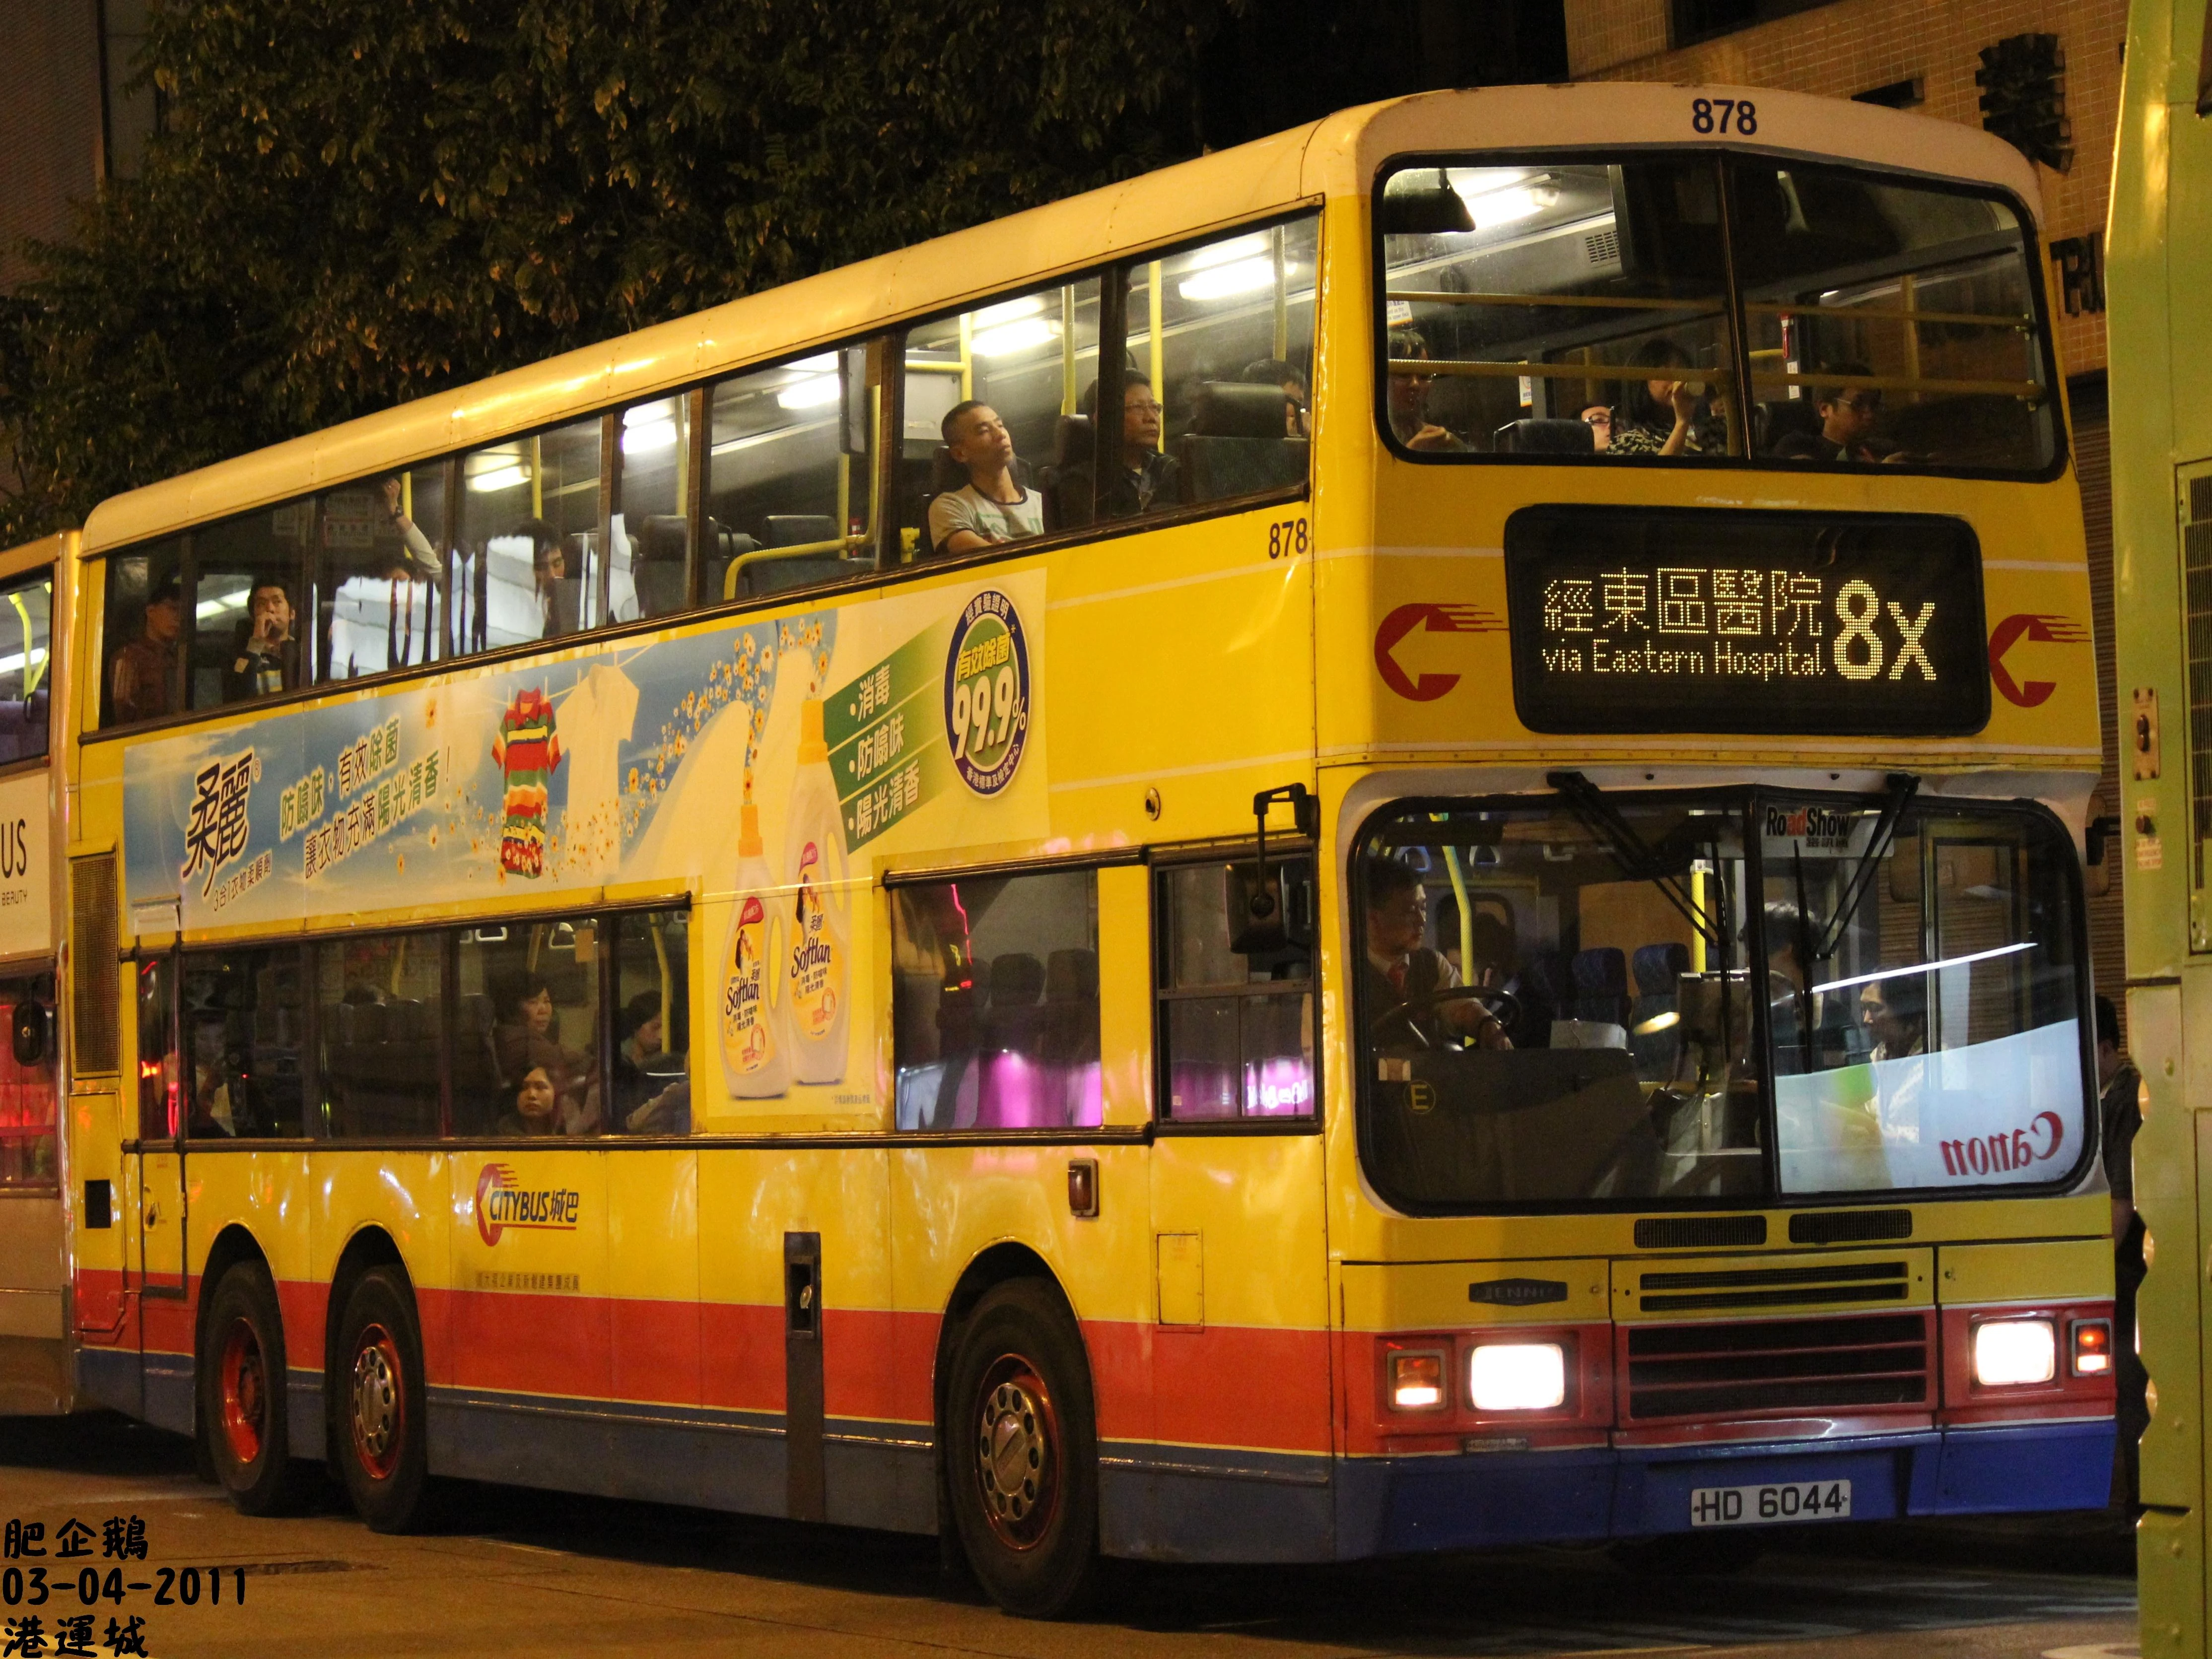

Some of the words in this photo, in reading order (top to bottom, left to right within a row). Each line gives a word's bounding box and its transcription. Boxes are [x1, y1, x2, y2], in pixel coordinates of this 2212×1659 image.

[1692, 98, 1757, 135] 878
[1269, 518, 1308, 559] 878
[1542, 567, 1823, 636] 經東區醫院
[1833, 579, 1937, 680] 8X
[957, 632, 1011, 681] 有效除菌
[1542, 639, 1582, 672] via
[1593, 638, 1704, 674] Eastern
[1715, 640, 1826, 682] Hospital
[857, 664, 891, 722] 消毒
[952, 665, 1027, 760] 99.9%
[856, 759, 920, 839] 陽光清香
[1766, 805, 1850, 837] RoadShow
[791, 937, 831, 978] Softlan
[726, 977, 760, 1016] Softlan
[1411, 1084, 1429, 1110] E
[489, 1191, 549, 1222] CITYBUS
[1700, 1490, 1742, 1522] HD
[1759, 1483, 1842, 1518] 6044
